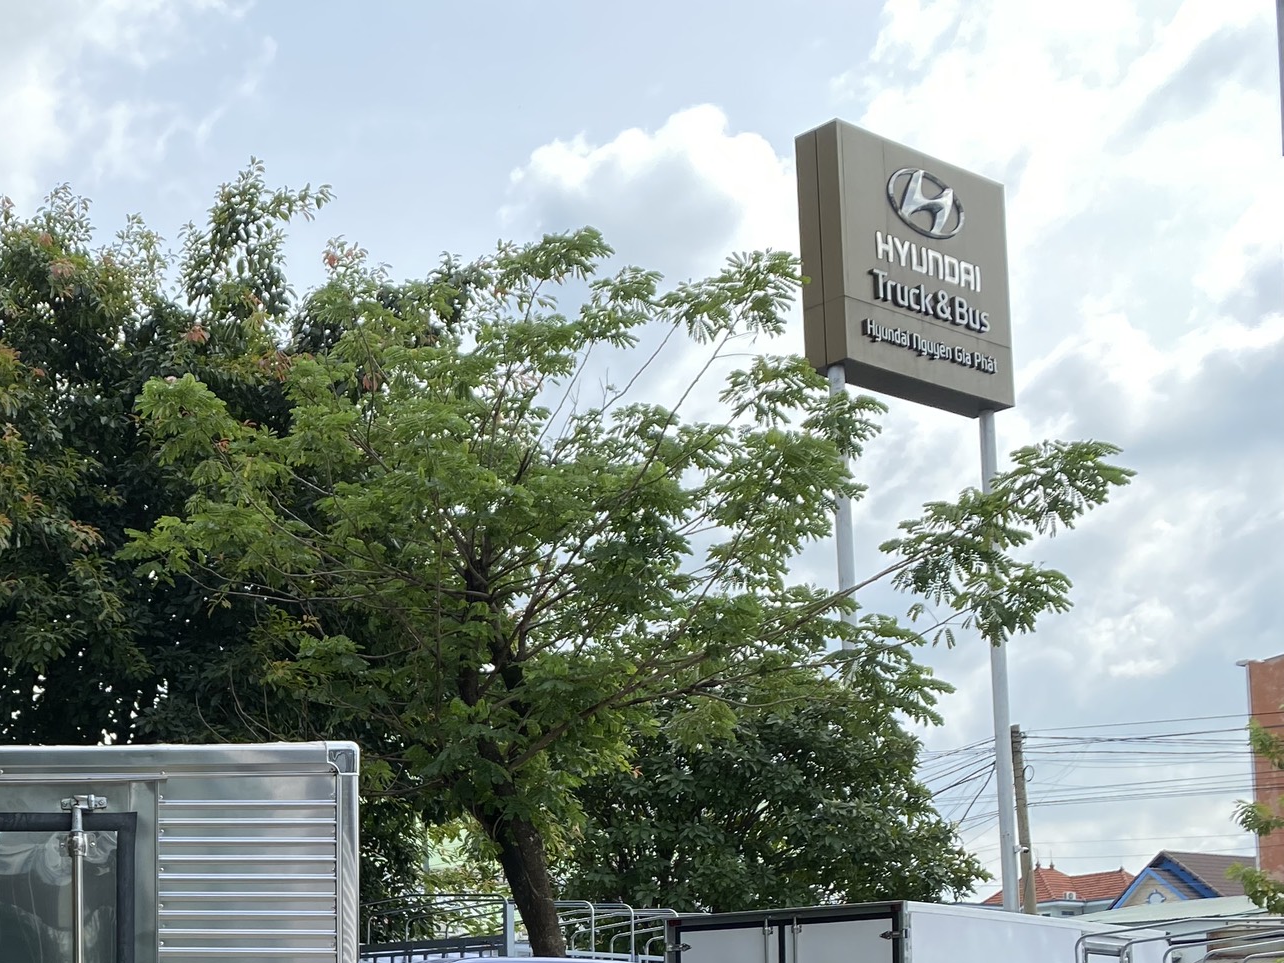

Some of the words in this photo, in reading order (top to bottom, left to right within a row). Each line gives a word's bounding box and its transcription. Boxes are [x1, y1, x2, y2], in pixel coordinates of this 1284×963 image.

[876, 231, 981, 293] HYUNDAI
[872, 268, 934, 315] Truck
[936, 289, 953, 321] &
[954, 296, 991, 333] Bus
[866, 318, 910, 347] Hyundai
[954, 345, 972, 365] Gia
[974, 351, 999, 374] Phát
